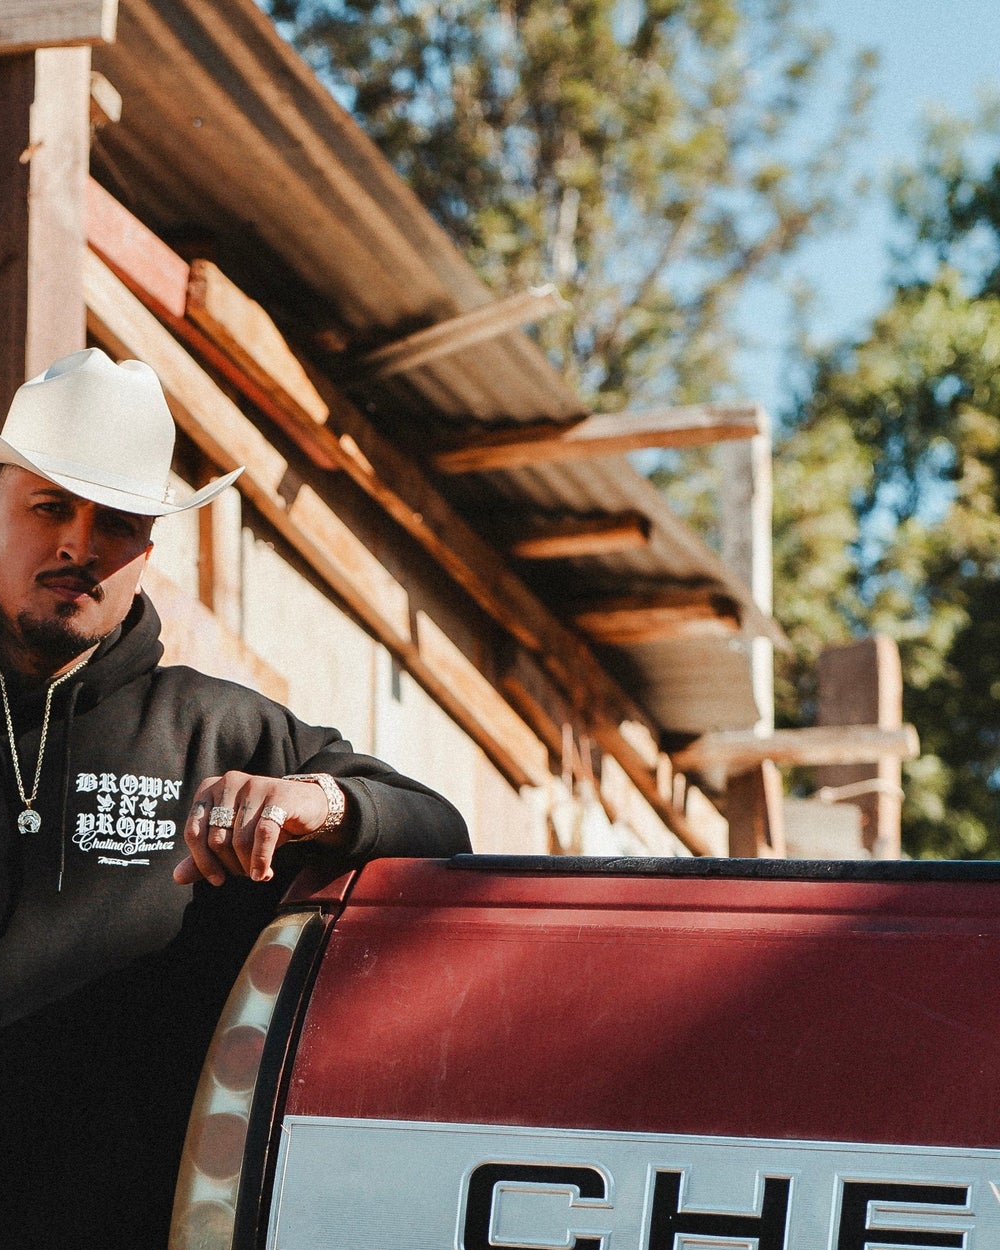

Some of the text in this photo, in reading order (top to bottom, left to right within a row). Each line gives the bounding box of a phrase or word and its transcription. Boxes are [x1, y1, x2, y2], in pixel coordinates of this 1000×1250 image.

[76, 773, 182, 801] BROWN
[118, 794, 139, 817] N
[75, 813, 176, 839] PROUD
[72, 830, 123, 852] Chalino
